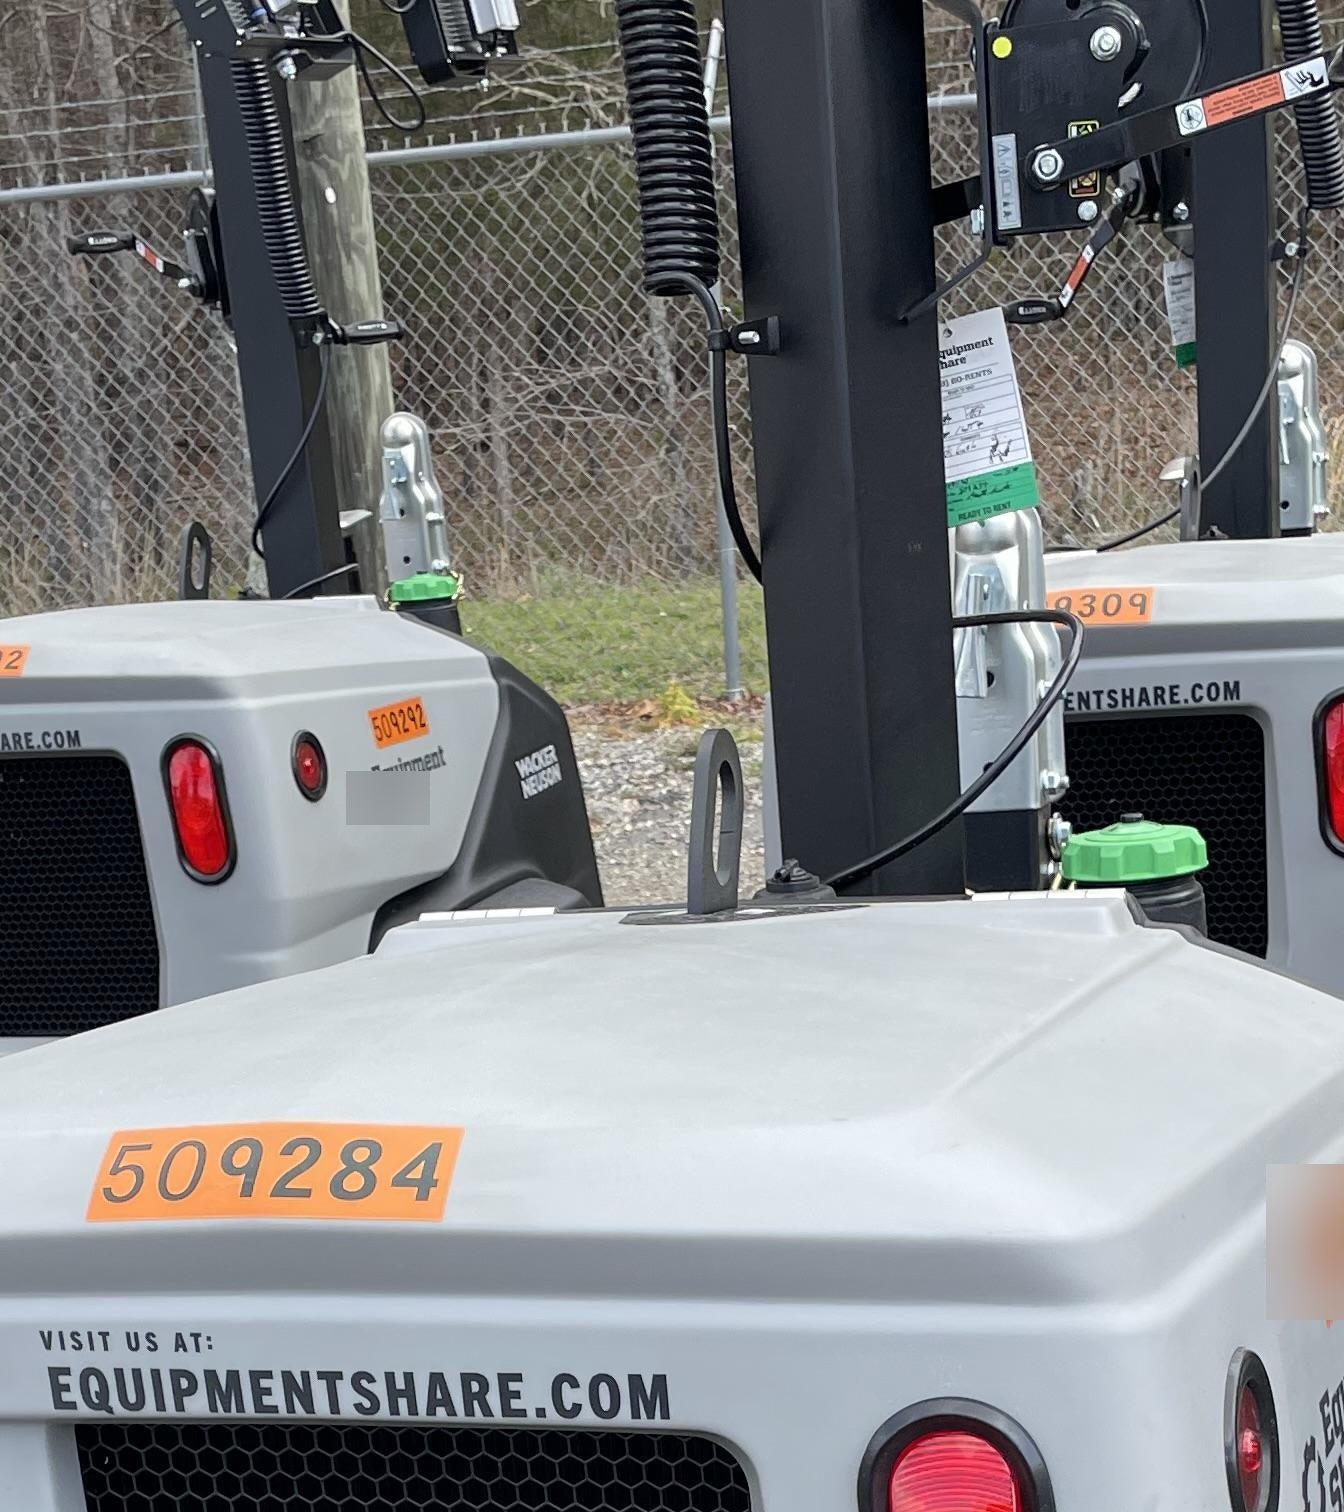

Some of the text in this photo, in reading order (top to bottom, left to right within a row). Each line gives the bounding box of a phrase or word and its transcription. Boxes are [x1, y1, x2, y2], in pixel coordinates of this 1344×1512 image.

[939, 337, 995, 359] quipment
[940, 356, 968, 369] hare
[1064, 680, 1241, 713] ENTSHARE.COM
[371, 703, 427, 742] 509292
[102, 1136, 443, 1204] 509284
[38, 1330, 214, 1353] VISIT US AT:
[47, 1365, 671, 1421] EQUIPMENTSHARE.COM
